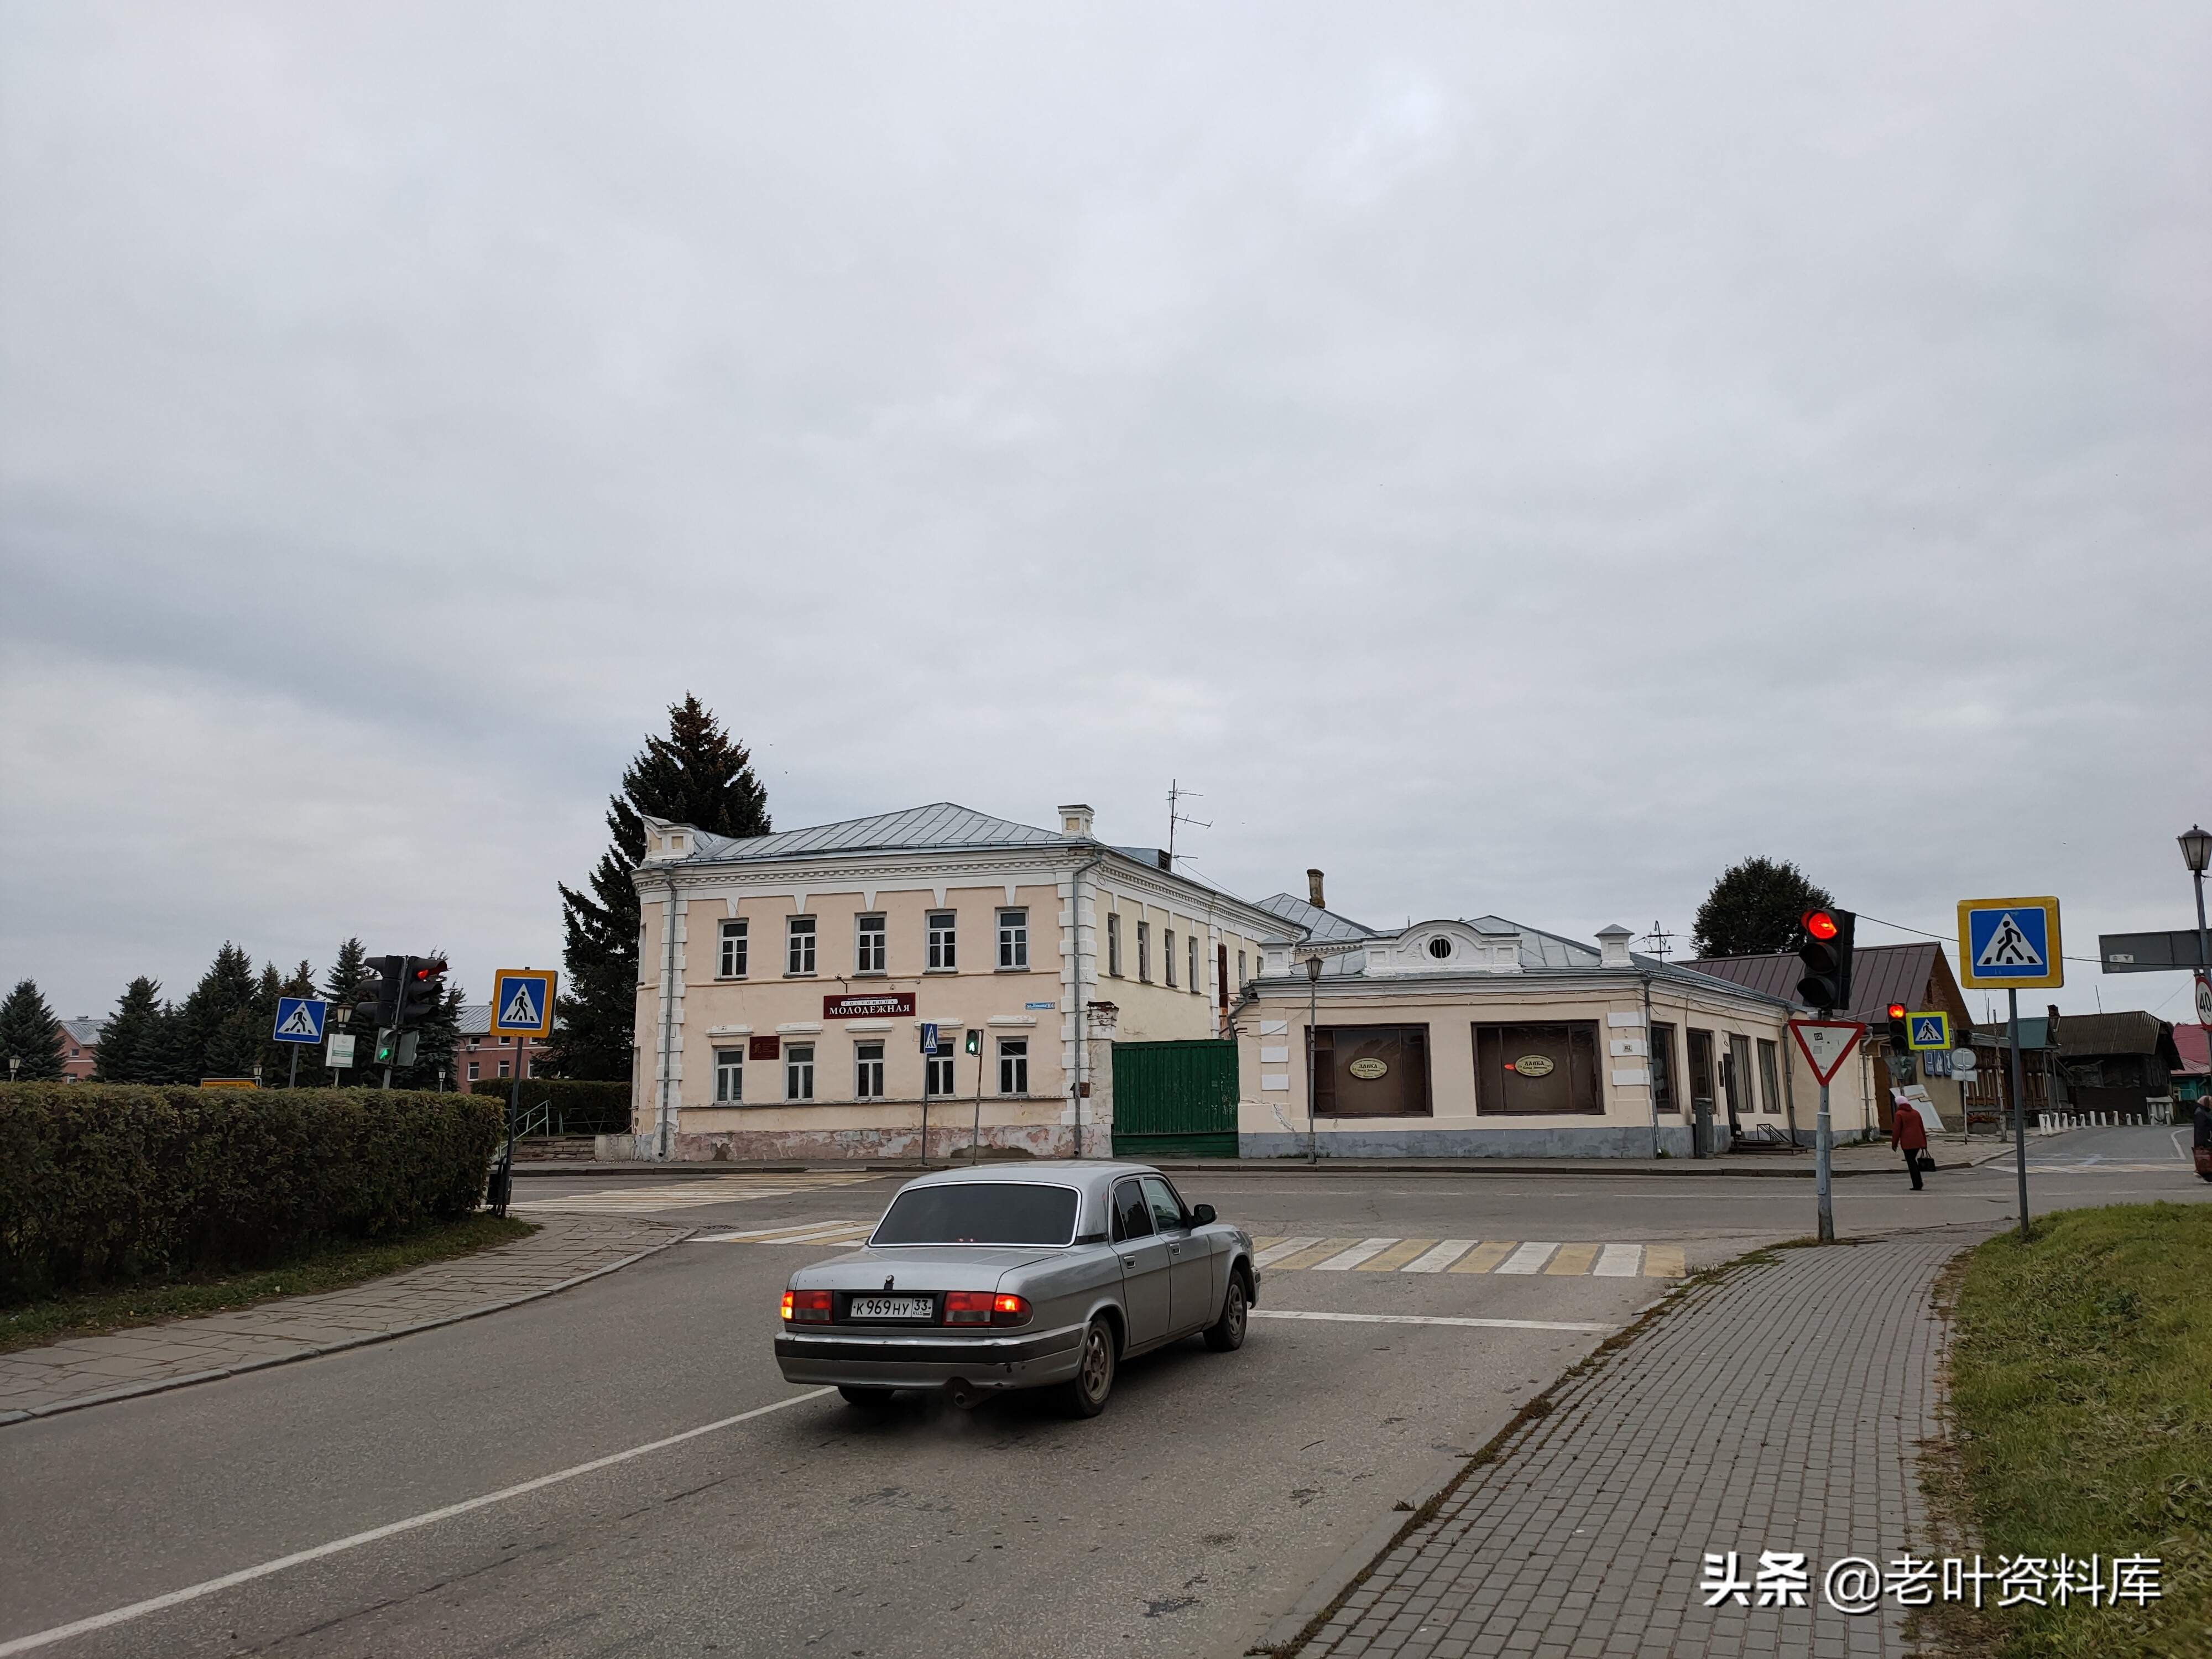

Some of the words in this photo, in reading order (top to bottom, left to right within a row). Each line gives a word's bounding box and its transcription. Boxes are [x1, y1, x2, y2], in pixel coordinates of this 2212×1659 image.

[2200, 992, 2211, 1013] 40
[830, 1004, 910, 1015] МОЛОДЕЖНАЯ
[914, 1300, 928, 1311] 33
